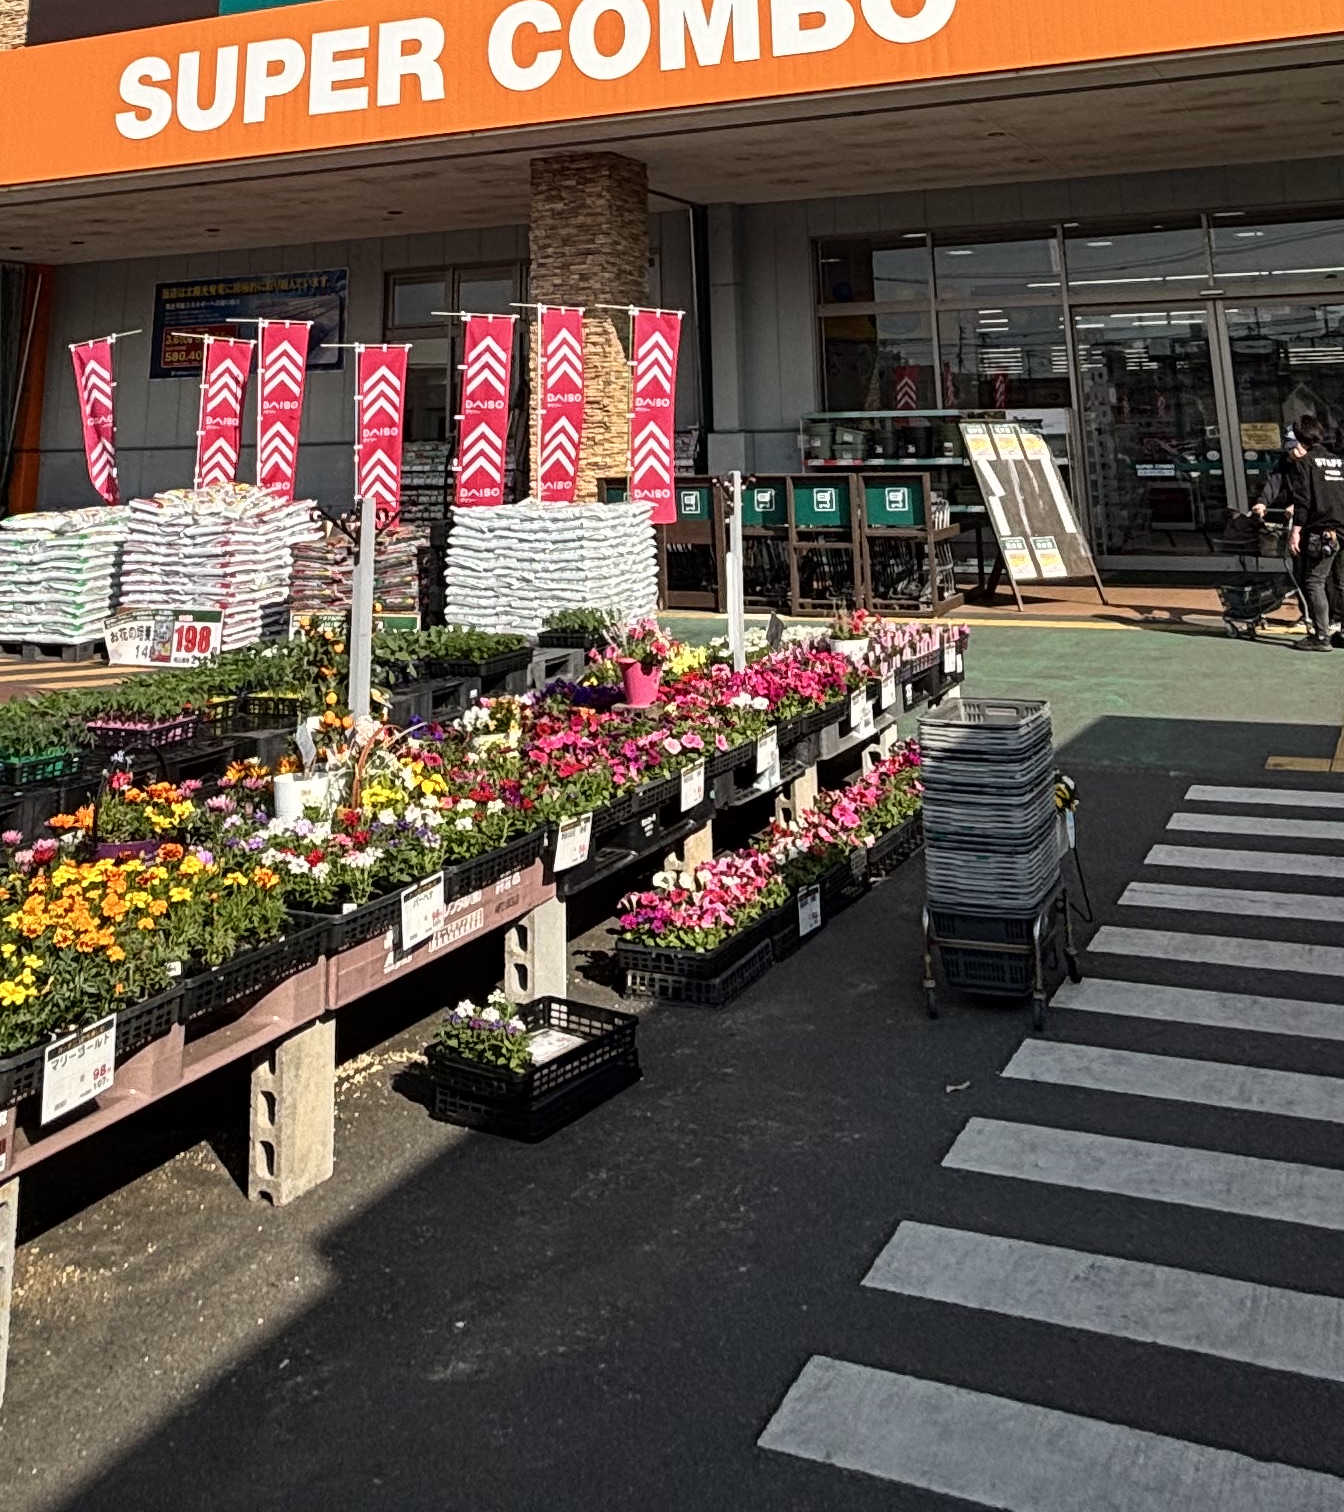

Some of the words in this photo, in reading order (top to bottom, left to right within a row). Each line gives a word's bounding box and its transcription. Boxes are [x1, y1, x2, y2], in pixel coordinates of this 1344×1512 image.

[115, 18, 445, 140] SUPER
[547, 393, 582, 403] DAISO
[635, 397, 670, 408] DAISO
[263, 401, 299, 410] DAISO
[465, 399, 504, 410] DAISO
[363, 427, 399, 438] DAISO
[1314, 457, 1343, 468] STAFF
[460, 487, 500, 498] DAISO
[634, 488, 671, 499] DAISO
[175, 625, 212, 653] 198
[51, 1034, 110, 1071] マリーゴールド
